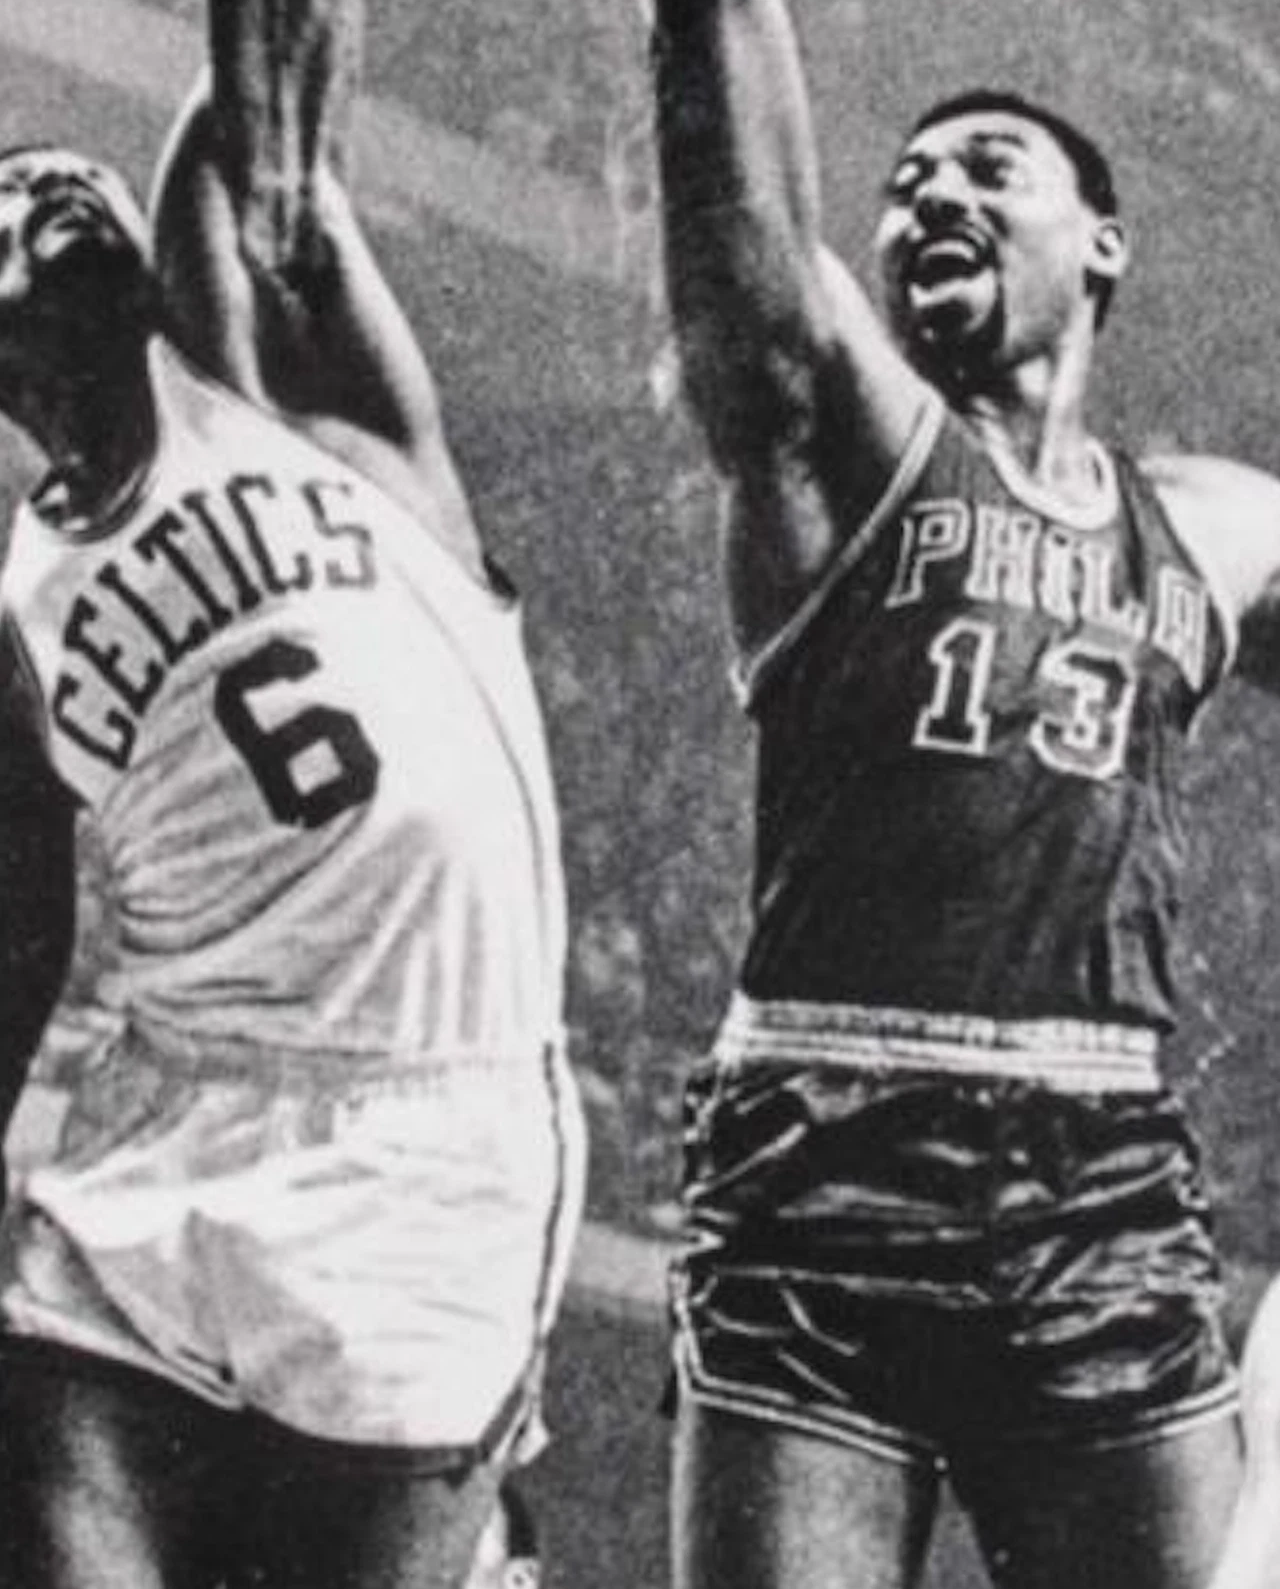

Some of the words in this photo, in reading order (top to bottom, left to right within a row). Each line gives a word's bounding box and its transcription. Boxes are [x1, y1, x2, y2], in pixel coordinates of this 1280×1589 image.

[51, 473, 377, 772] CELTICS
[911, 616, 1138, 782] 13
[213, 634, 382, 830] 6
